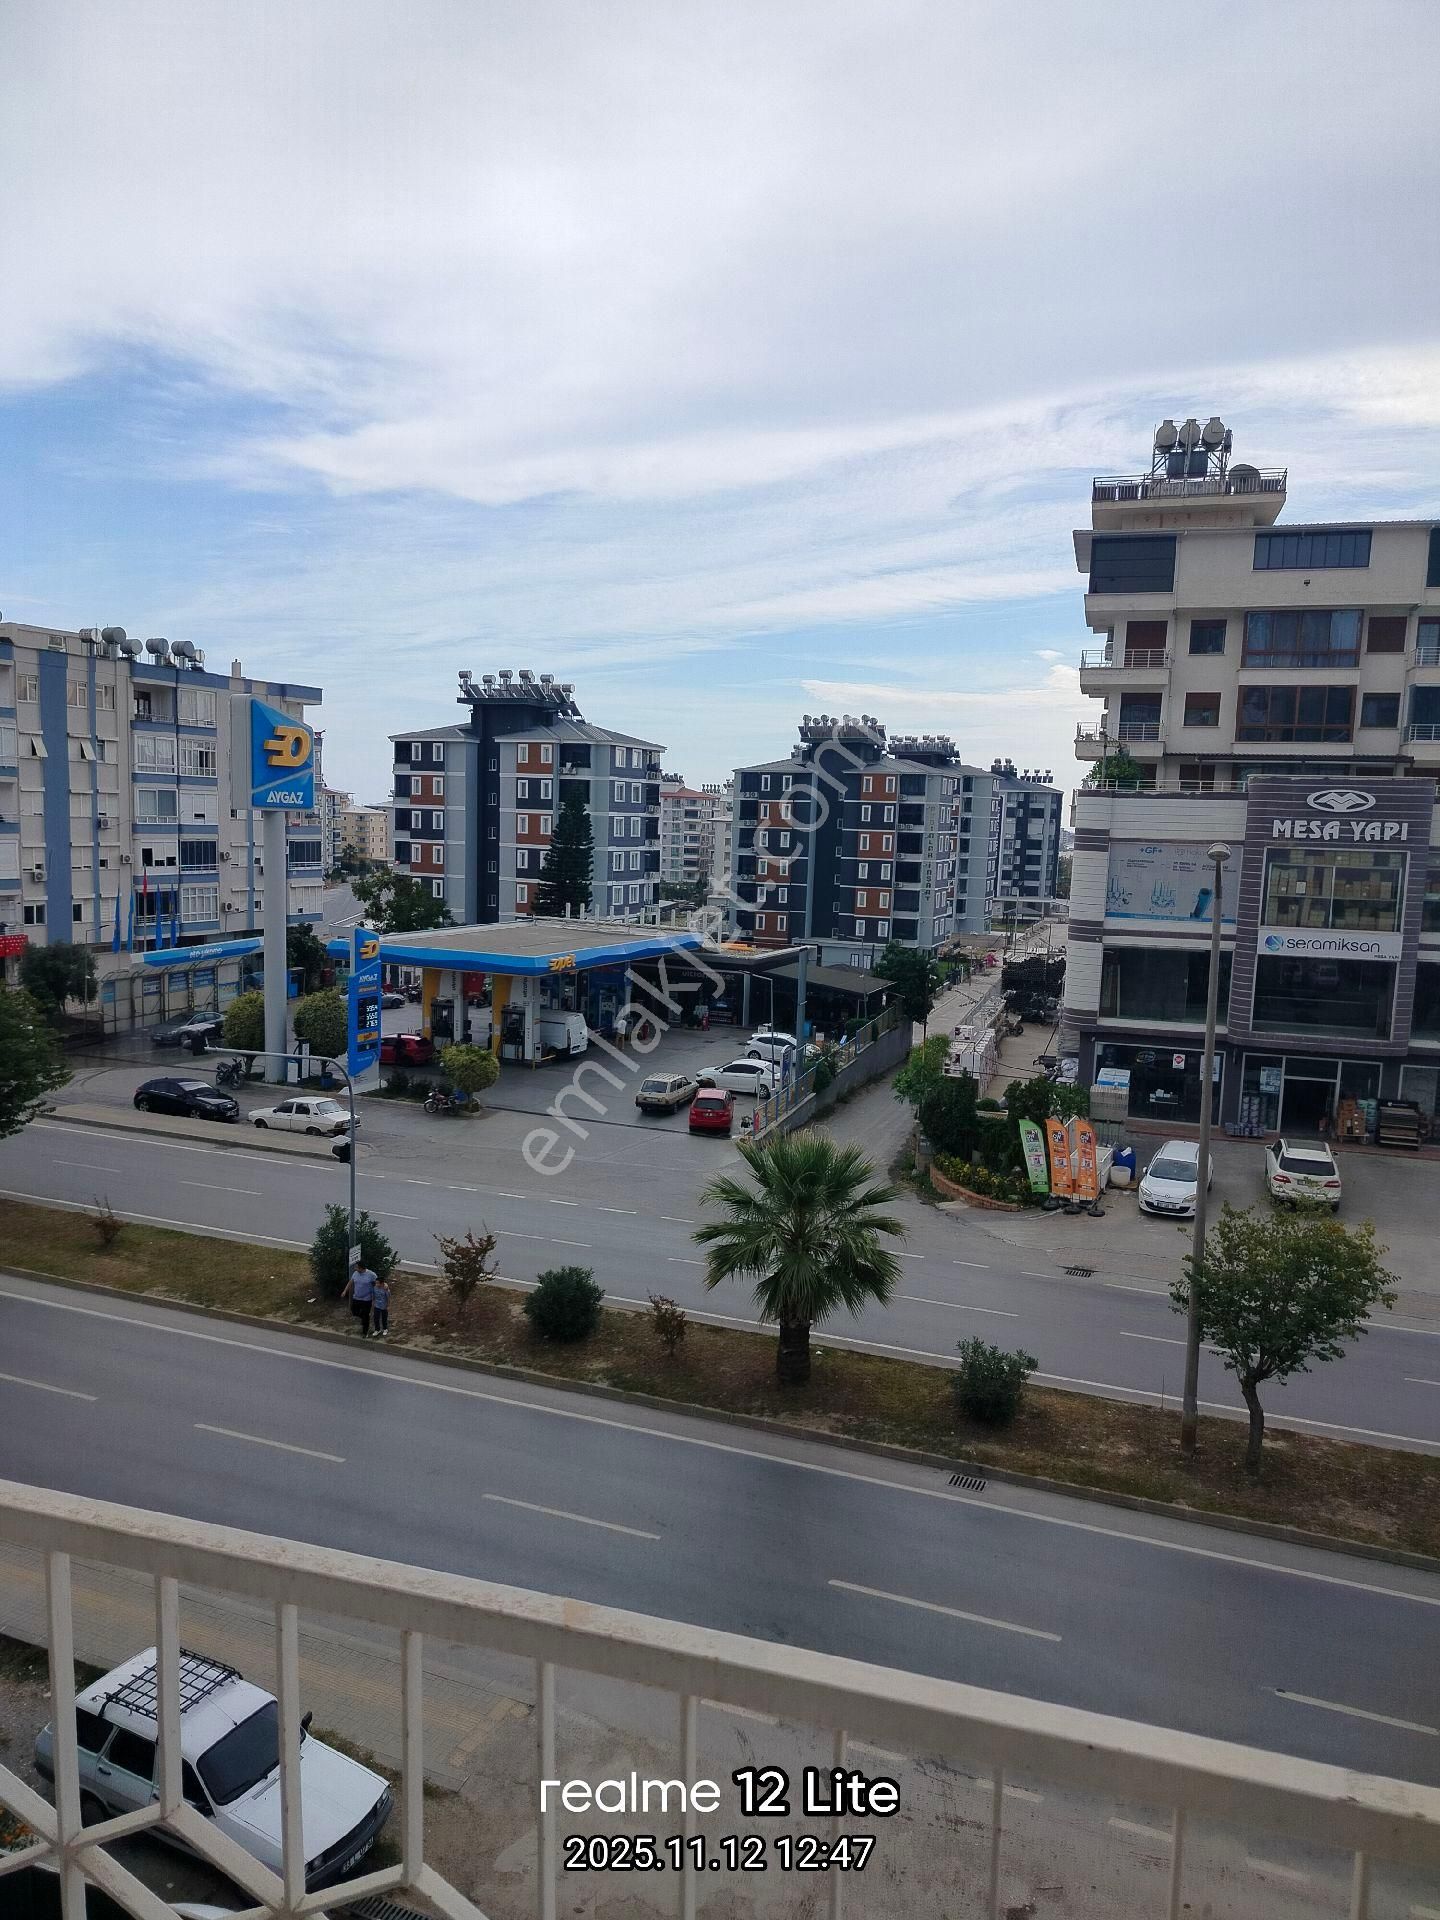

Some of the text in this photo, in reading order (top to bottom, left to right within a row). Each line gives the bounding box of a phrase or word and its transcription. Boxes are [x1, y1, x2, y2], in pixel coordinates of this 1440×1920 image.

[266, 791, 304, 804] AYGAZ
[1272, 819, 1409, 842] MESA YAPI
[1286, 937, 1380, 953] seramiksan
